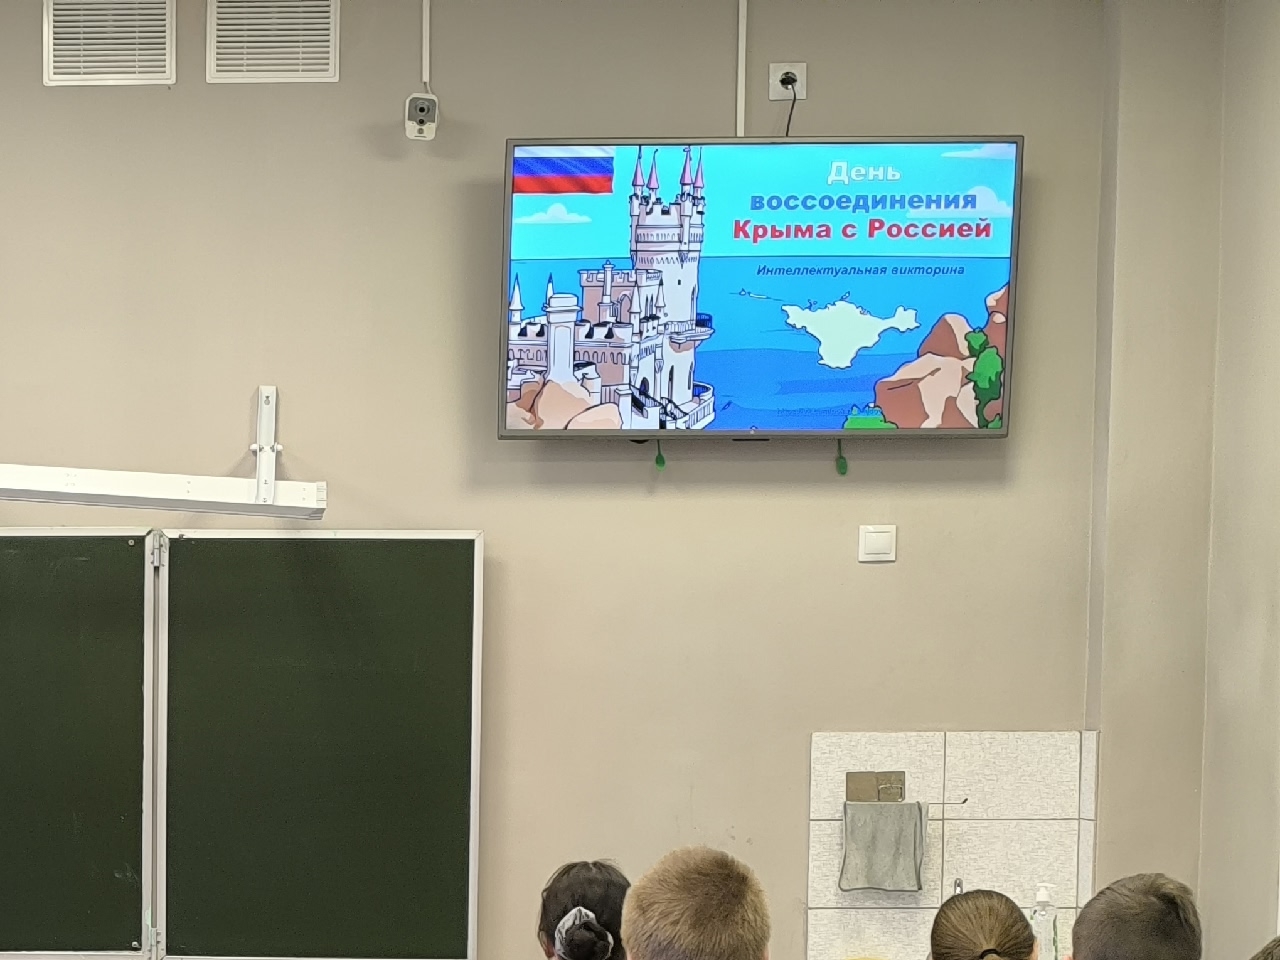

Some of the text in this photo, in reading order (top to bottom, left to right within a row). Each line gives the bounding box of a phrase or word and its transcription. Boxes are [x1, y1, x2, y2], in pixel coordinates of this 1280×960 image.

[826, 160, 902, 185] День
[750, 194, 977, 214] воссоединения
[733, 217, 992, 244] Крыма с Россией
[756, 265, 965, 278] Интеллектуальная викторина
